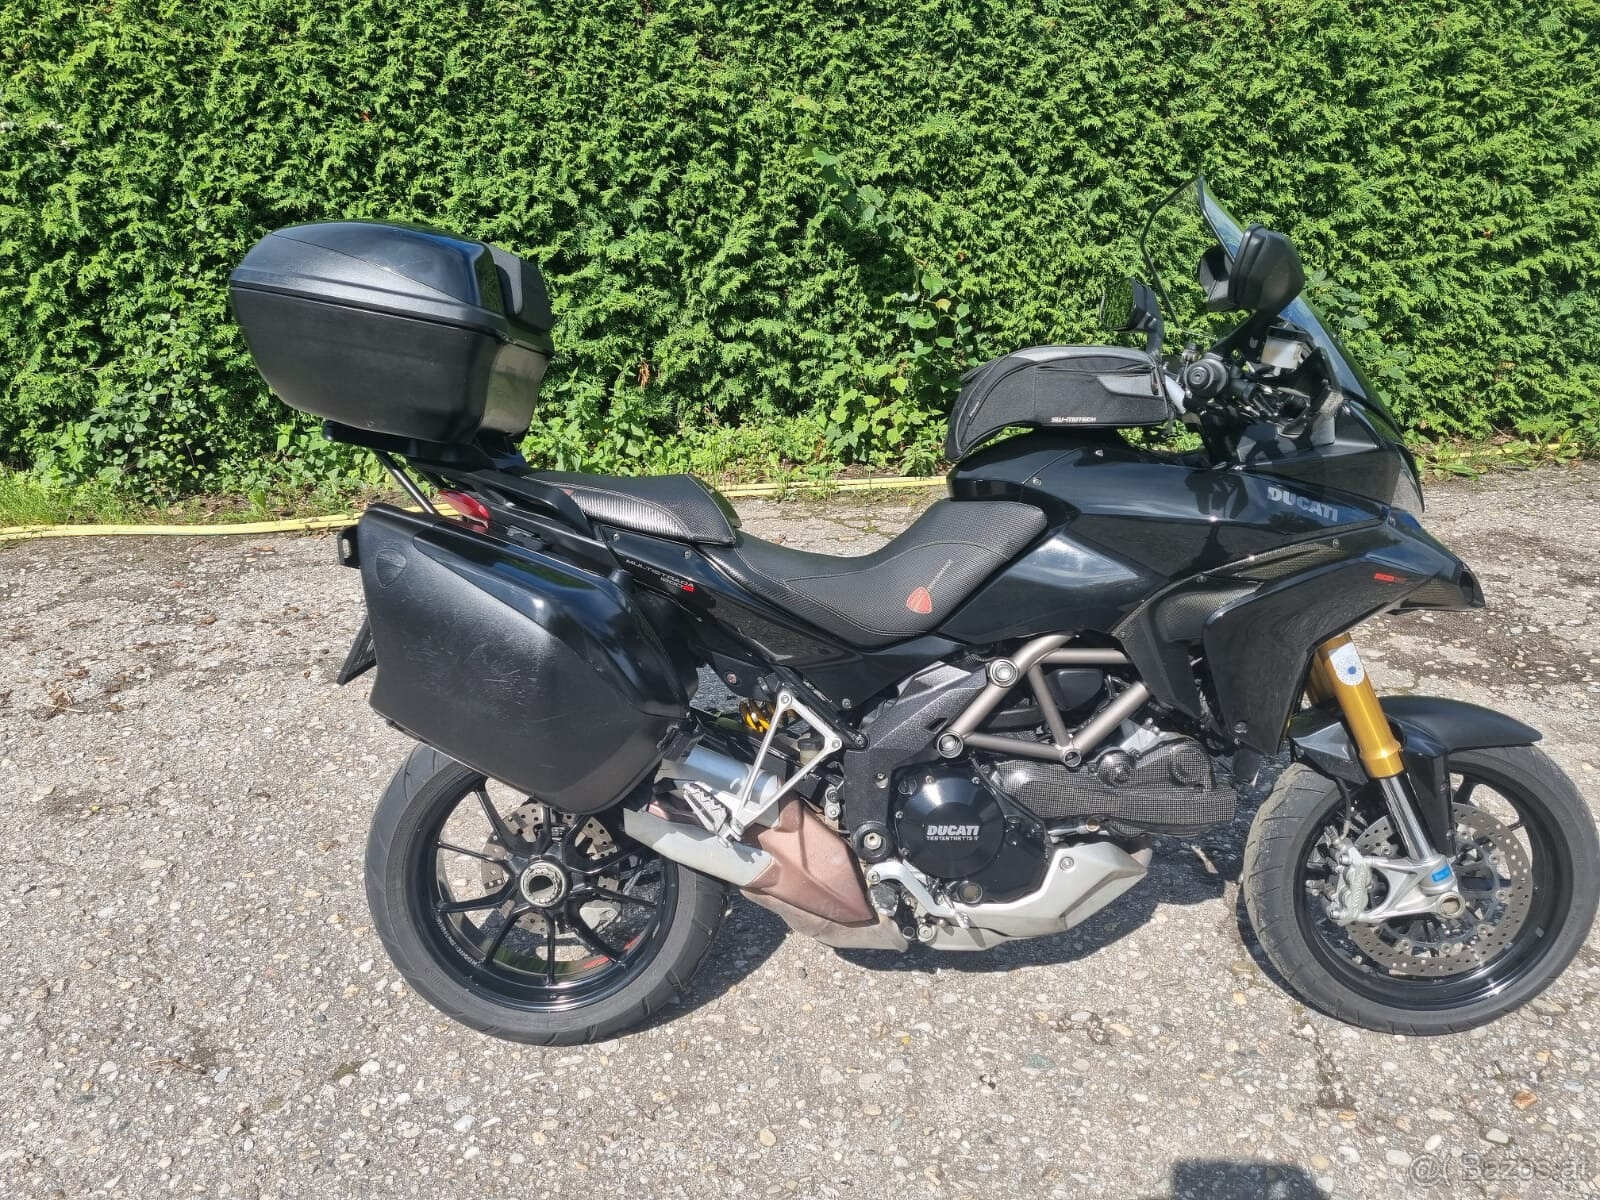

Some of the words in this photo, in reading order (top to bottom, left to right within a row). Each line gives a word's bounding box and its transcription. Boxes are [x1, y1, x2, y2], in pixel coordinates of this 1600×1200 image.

[1267, 486, 1338, 522] DUCATI
[625, 559, 694, 588] MULTISTRADA
[926, 825, 980, 836] DUCATI
